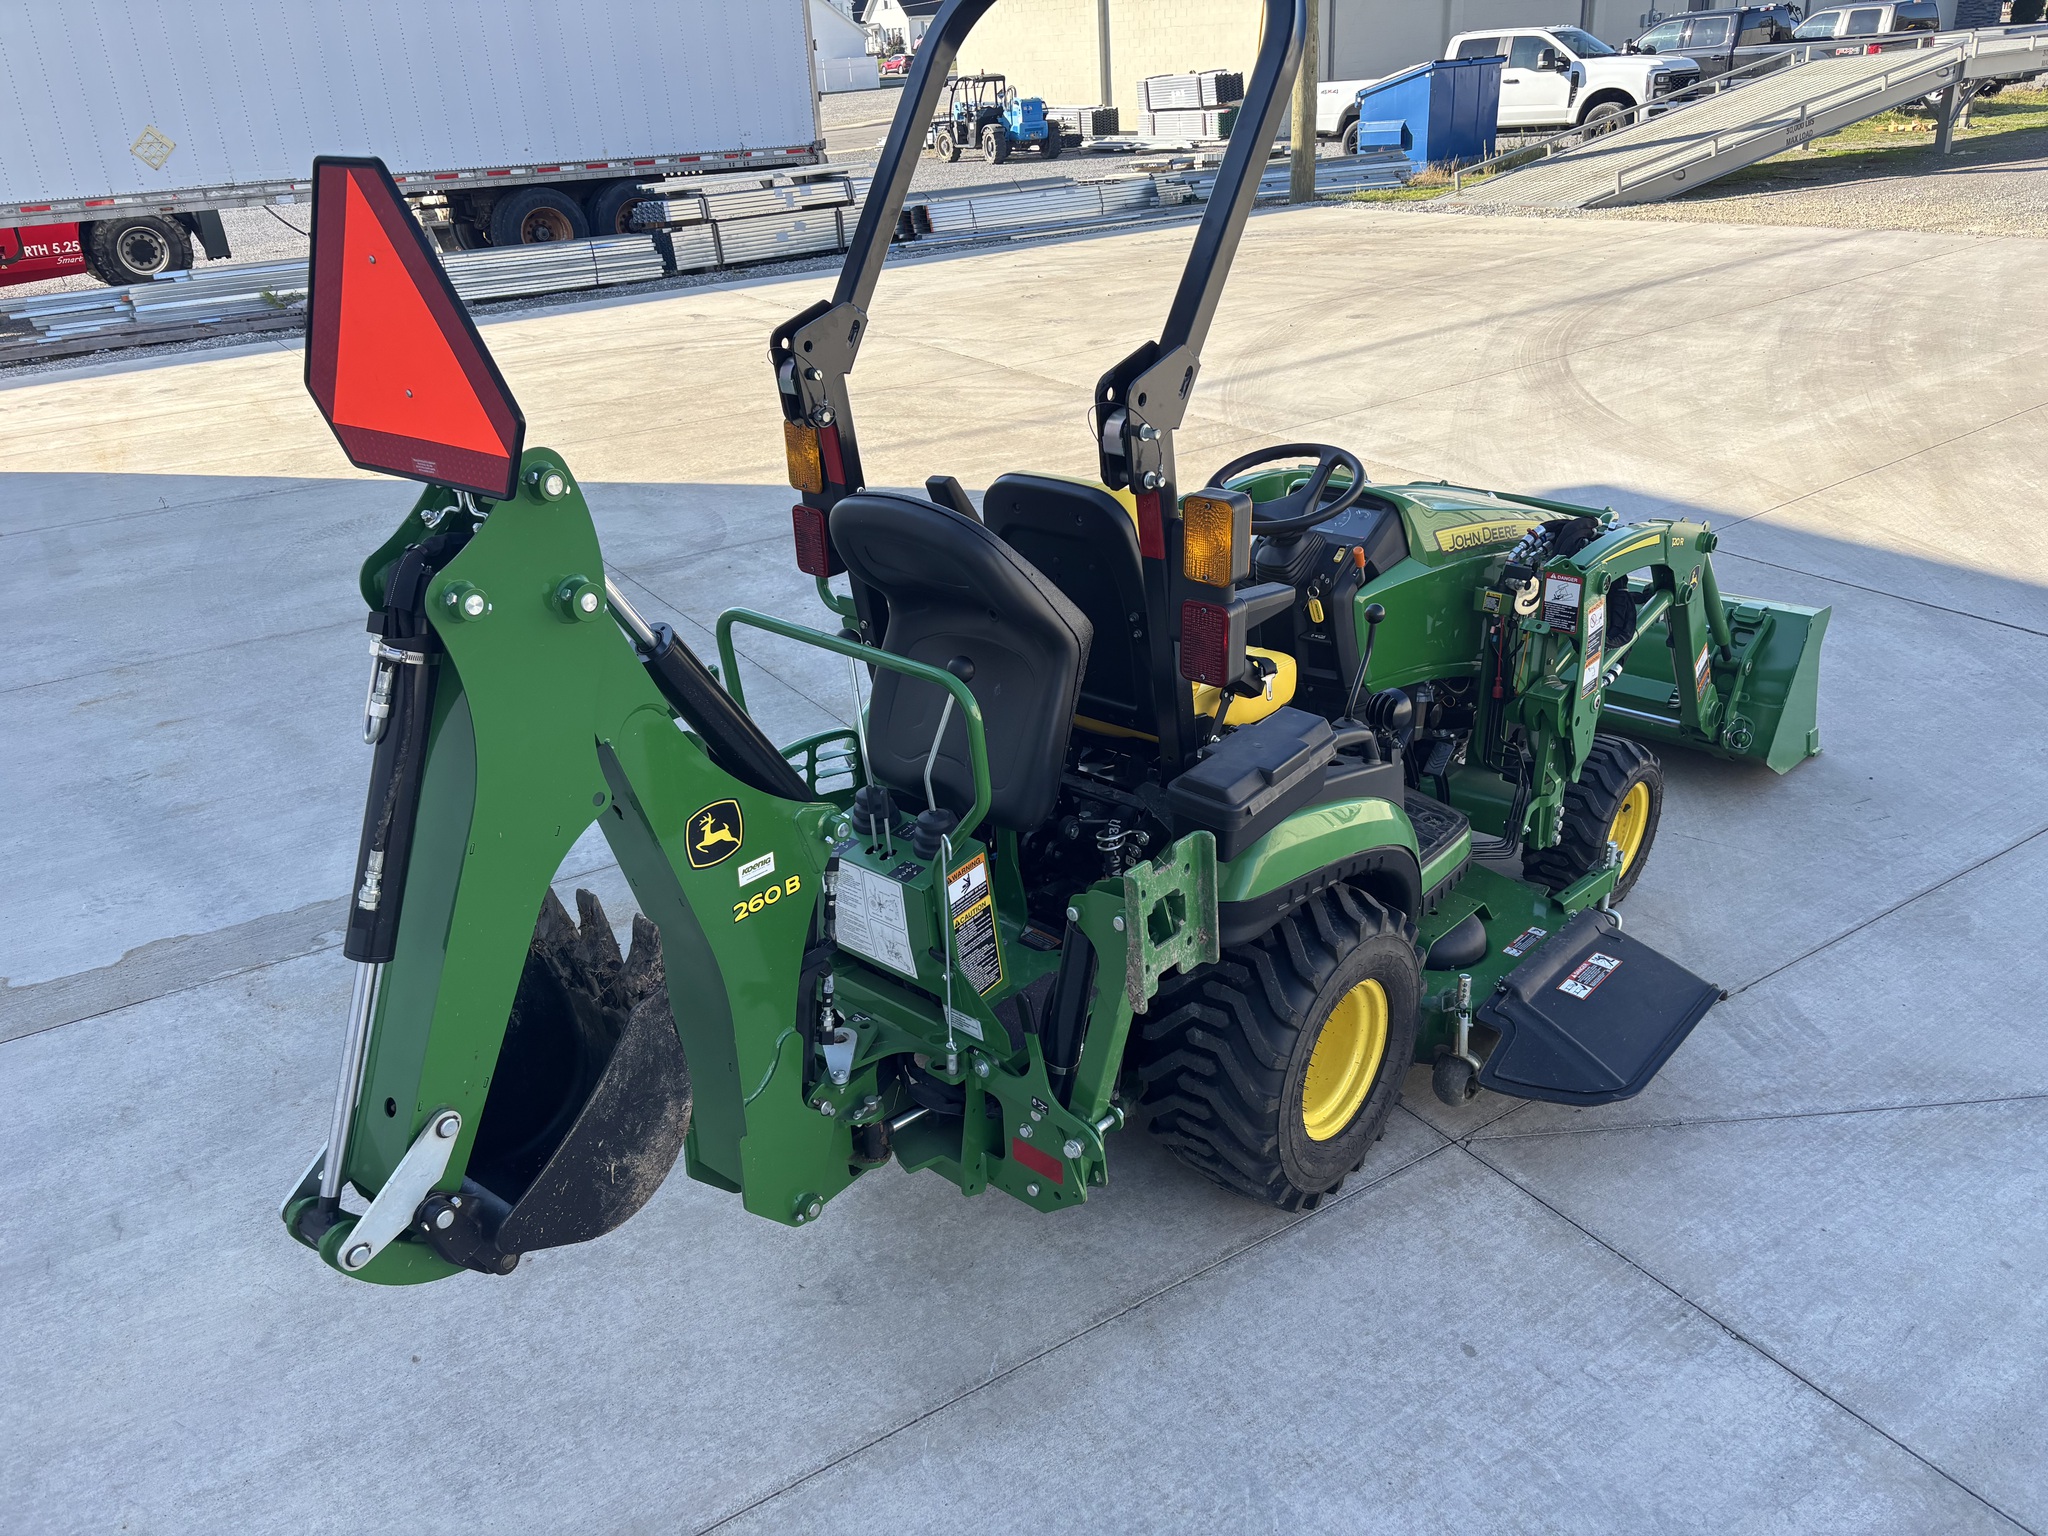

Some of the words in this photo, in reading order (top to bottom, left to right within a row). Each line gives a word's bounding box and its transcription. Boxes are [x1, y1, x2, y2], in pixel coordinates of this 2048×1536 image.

[1786, 134, 1799, 147] MAX
[1799, 130, 1814, 141] LOAD
[24, 244, 49, 257] RTH
[52, 240, 80, 254] 5.25
[57, 256, 84, 264] Smart
[1448, 532, 1480, 550] JOHN
[1481, 525, 1518, 541] DEERE
[1557, 575, 1578, 583] DANGER
[952, 857, 981, 879] WARNING
[733, 885, 782, 923] 260
[785, 874, 802, 896] B
[960, 901, 987, 923] CAUTION
